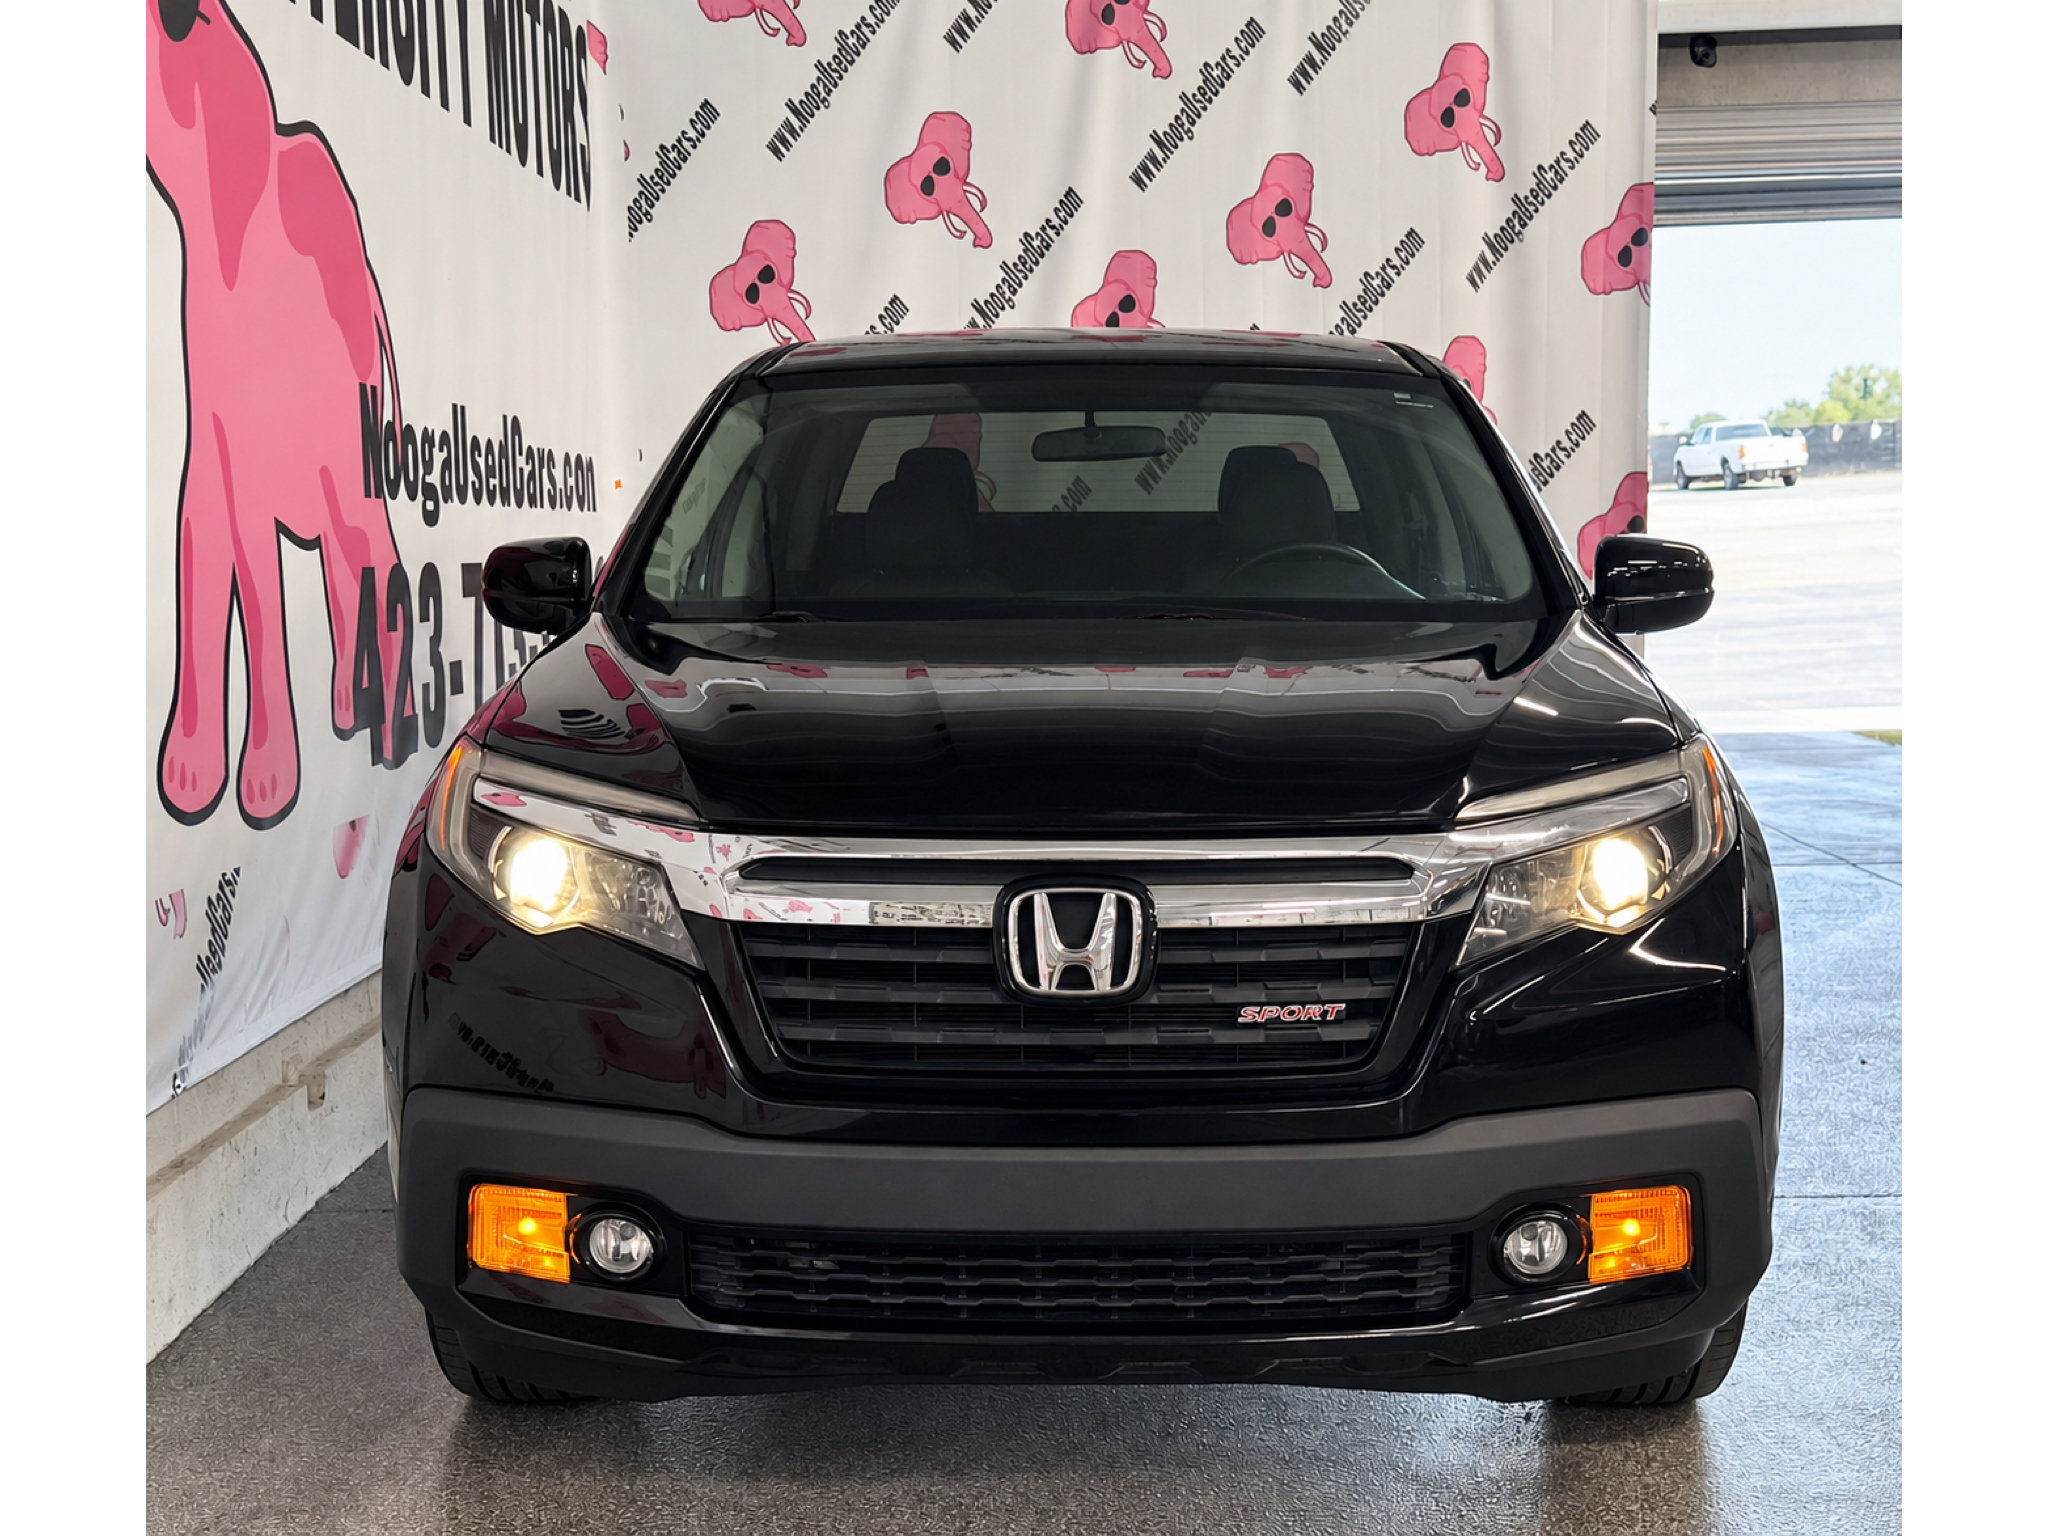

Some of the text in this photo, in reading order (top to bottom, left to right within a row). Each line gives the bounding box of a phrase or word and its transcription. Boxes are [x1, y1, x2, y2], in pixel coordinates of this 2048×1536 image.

[943, 0, 1000, 53] www.No
[483, 0, 591, 212] MOTORS
[627, 97, 721, 243] oogaUsedCars.com
[1128, 16, 1266, 192] www.NoogaUsedCars.com
[963, 186, 1084, 330] w.NoogaUsedCars.com
[1465, 120, 1601, 293] www.NoogaUsedCars.com
[1328, 227, 1426, 336] aUsedCars.com
[1528, 410, 1597, 493] dCars.com
[1238, 1003, 1346, 1024] SPORT
